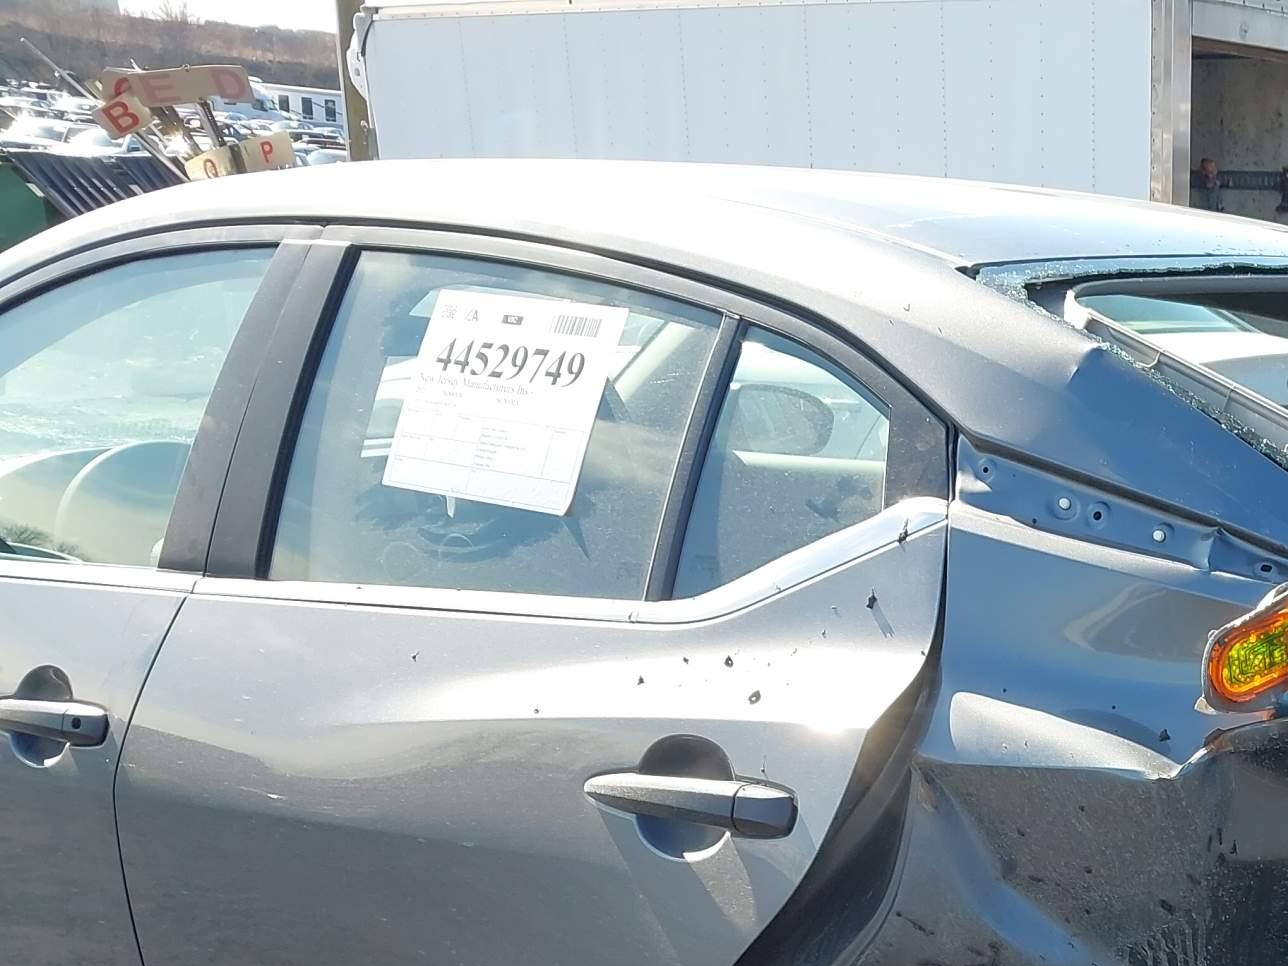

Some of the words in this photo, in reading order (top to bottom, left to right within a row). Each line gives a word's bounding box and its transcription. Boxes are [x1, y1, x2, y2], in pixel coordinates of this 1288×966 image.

[143, 74, 181, 106] E
[210, 69, 247, 100] D
[102, 100, 140, 134] B
[260, 141, 273, 164] P
[435, 337, 586, 388] 44529749
